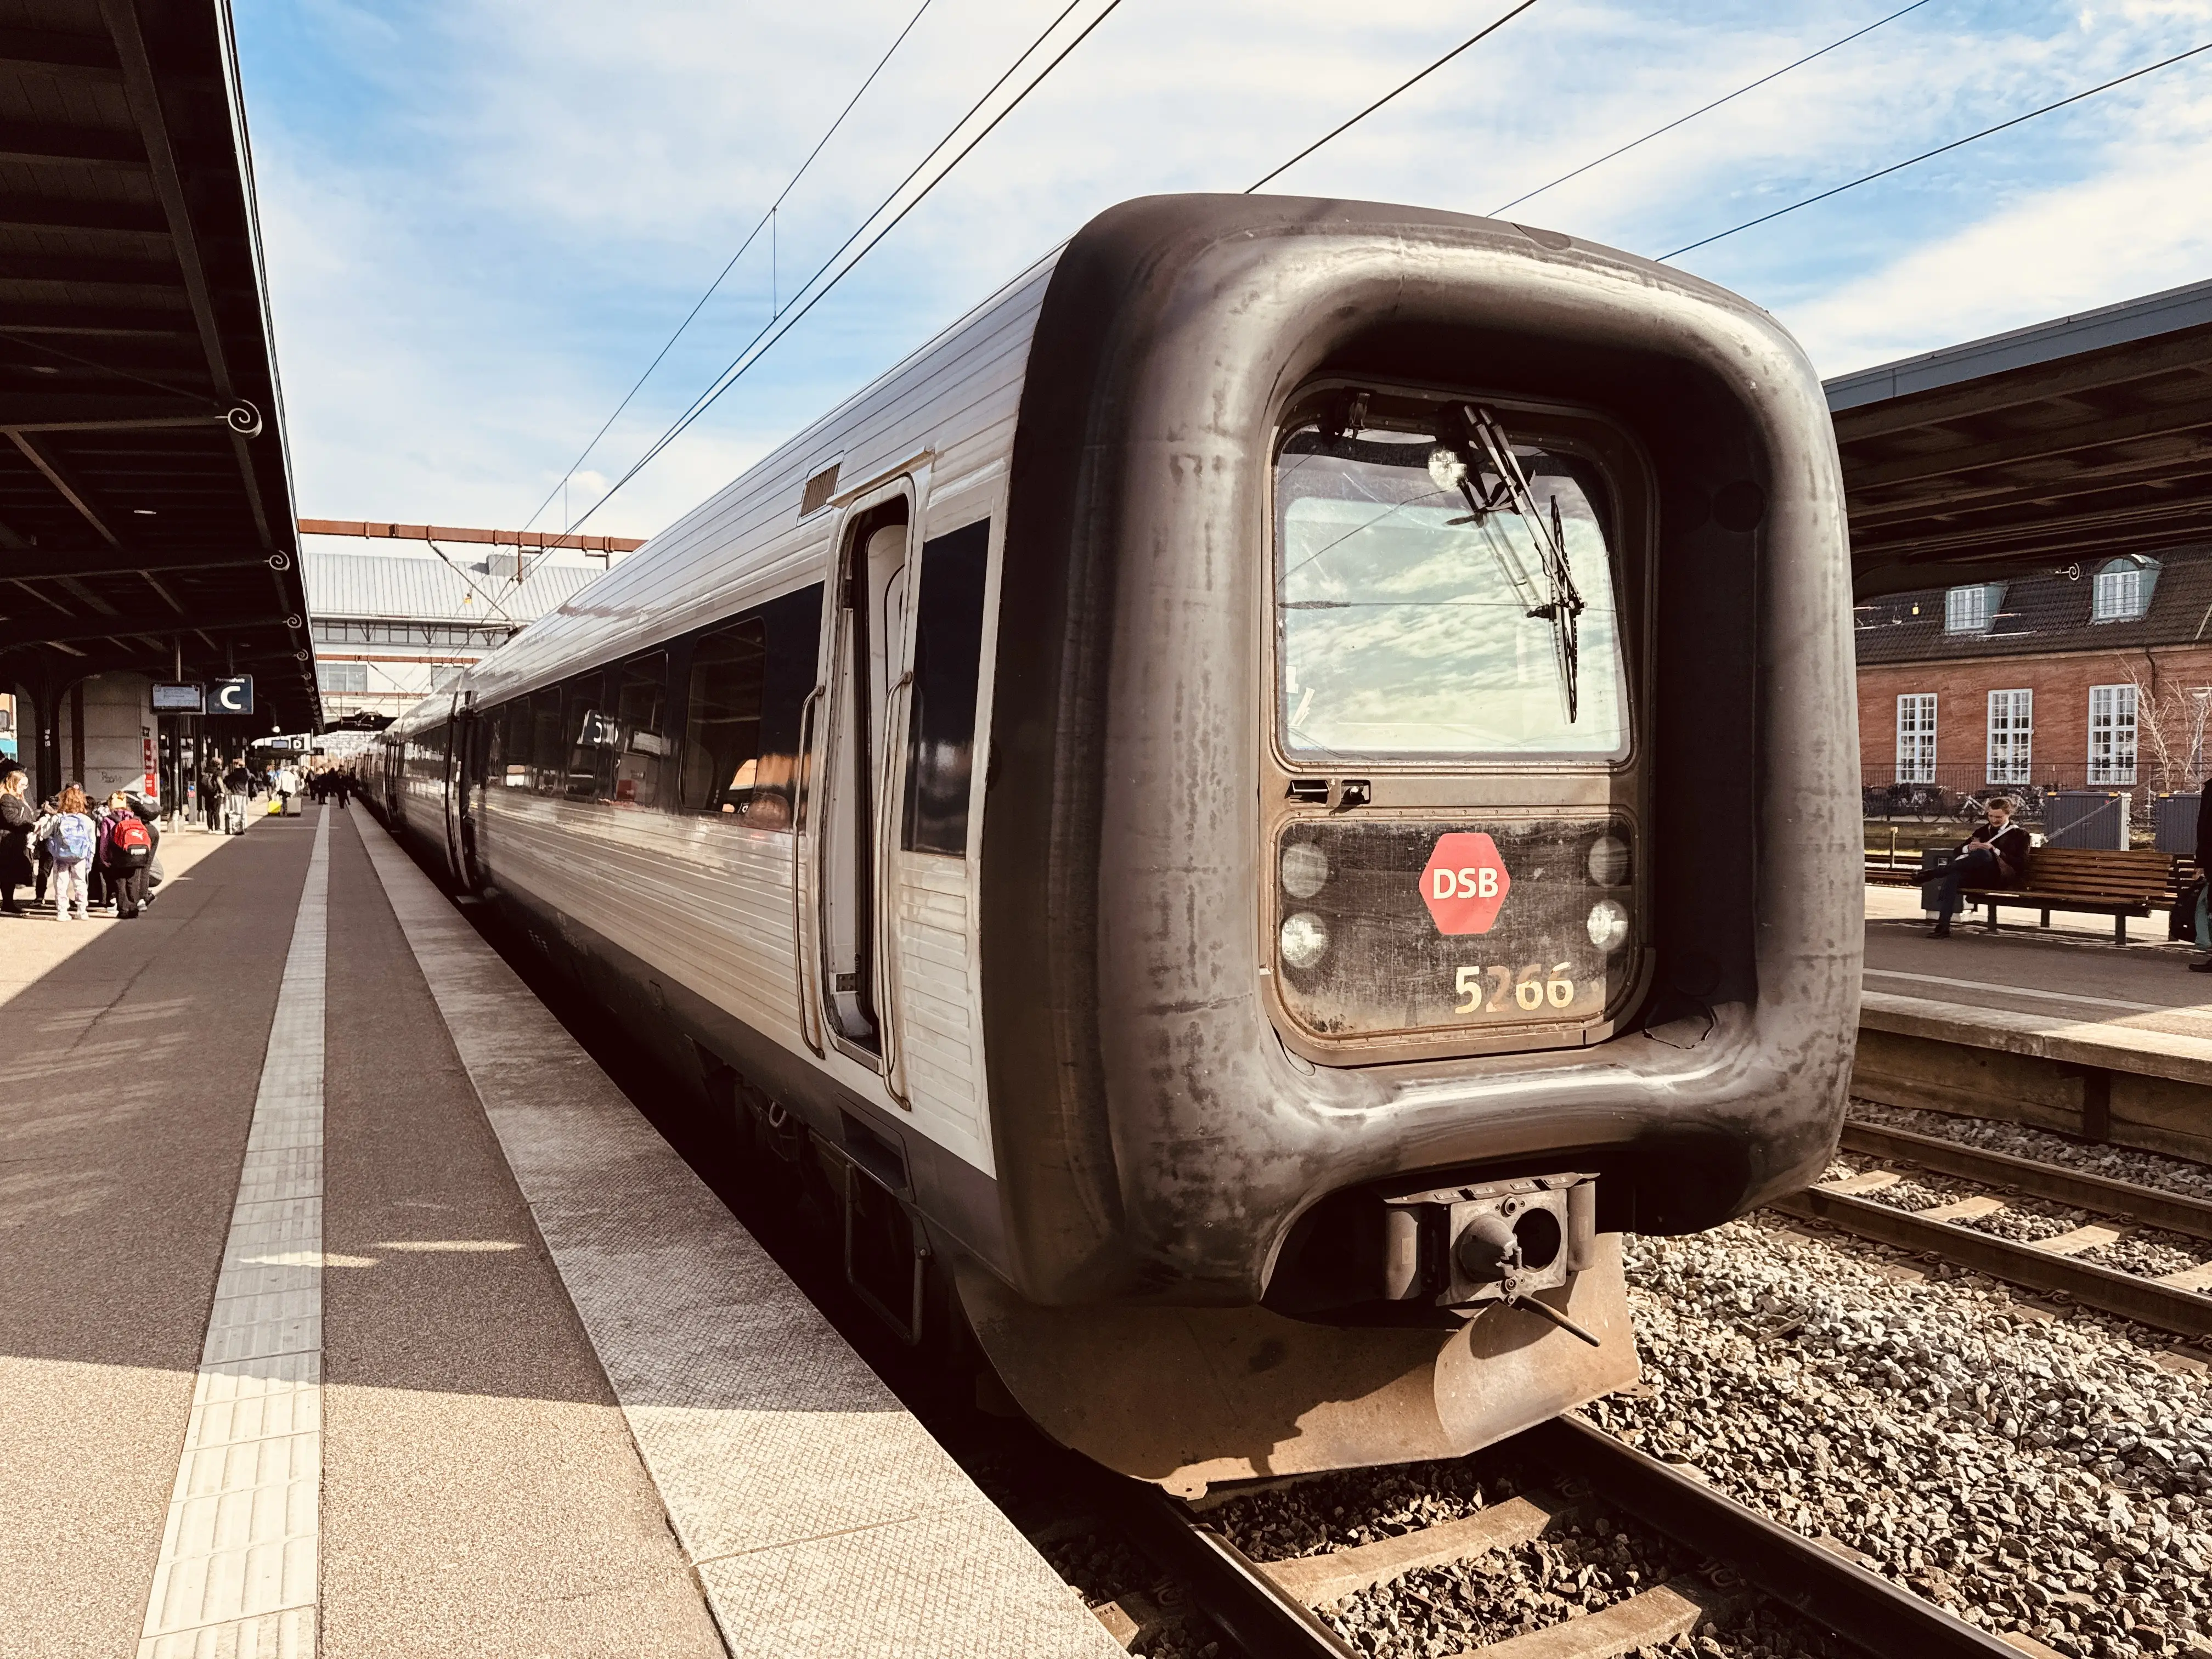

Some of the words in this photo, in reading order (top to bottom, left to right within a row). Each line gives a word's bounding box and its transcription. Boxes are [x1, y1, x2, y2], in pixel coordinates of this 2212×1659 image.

[221, 686, 241, 709] C
[293, 740, 302, 749] D
[1433, 867, 1498, 899] DSB
[1455, 962, 1574, 1014] 5266
